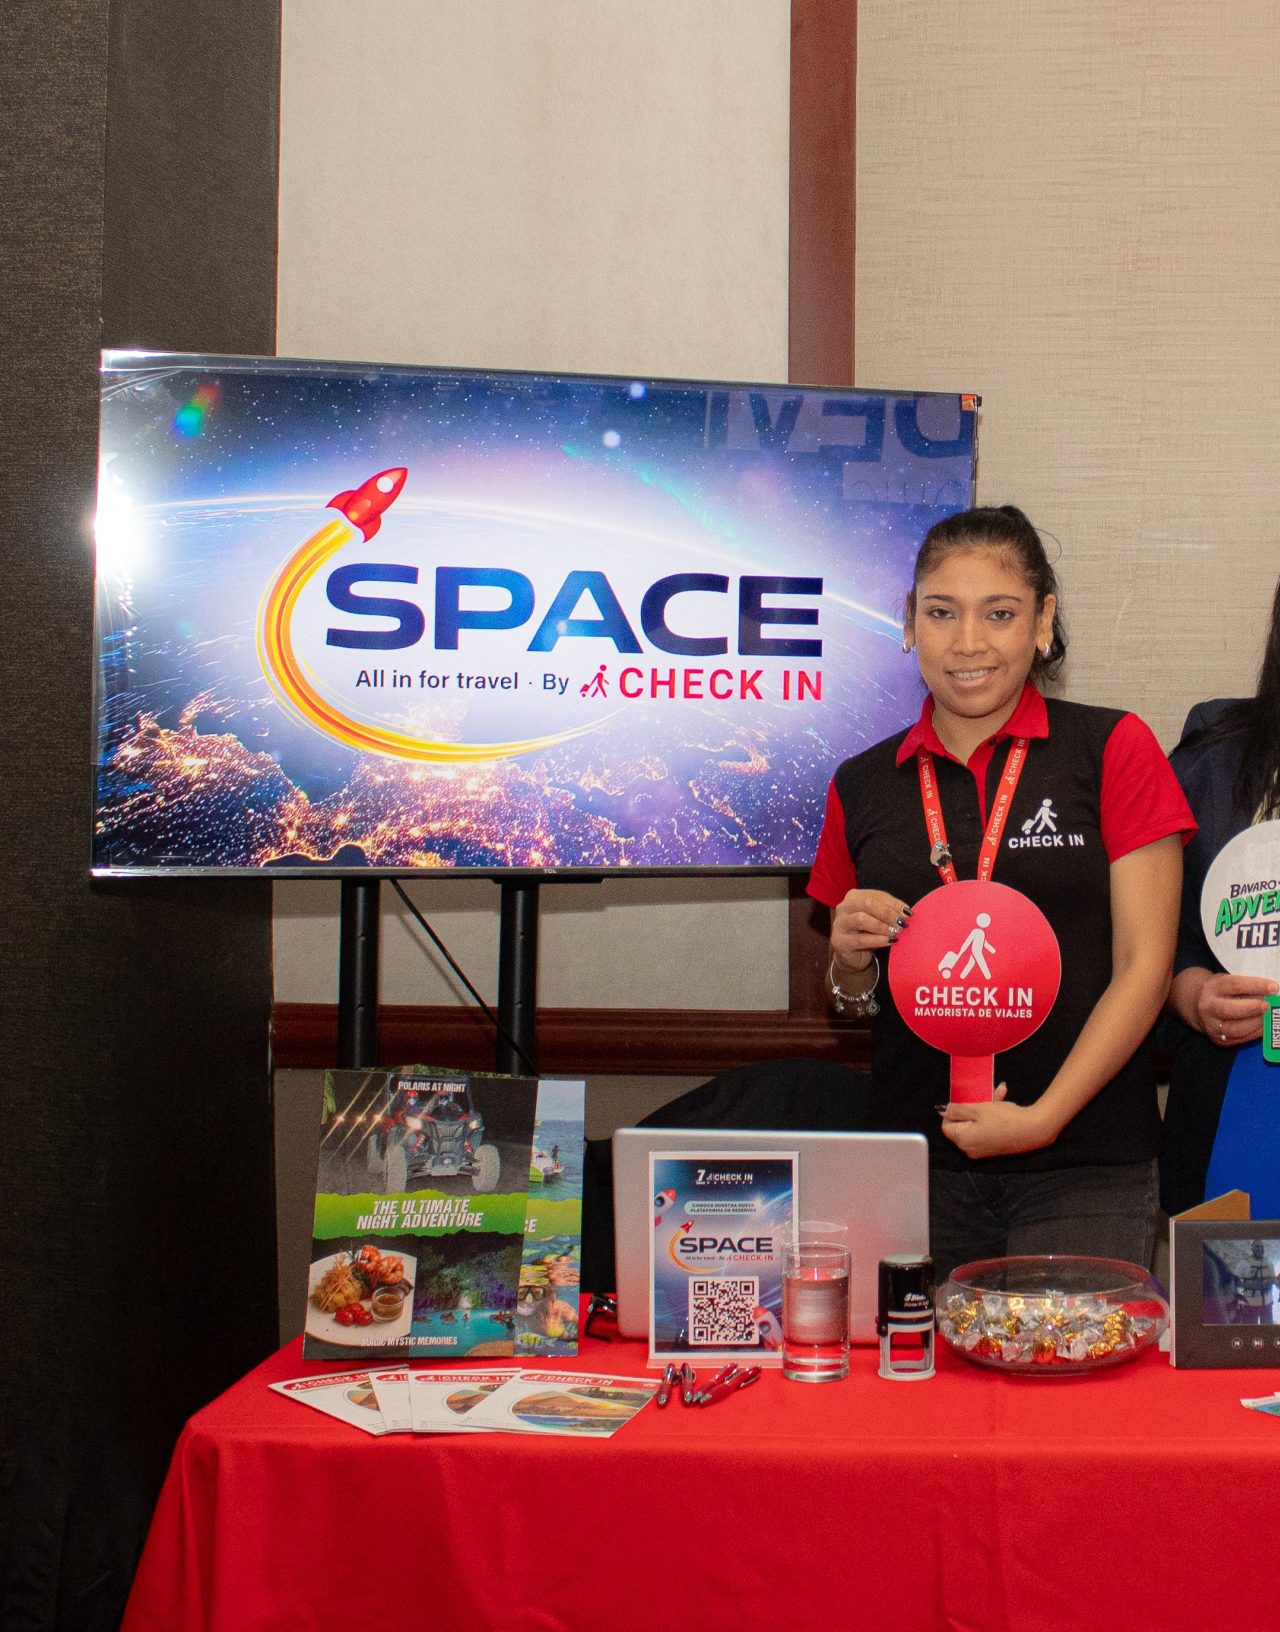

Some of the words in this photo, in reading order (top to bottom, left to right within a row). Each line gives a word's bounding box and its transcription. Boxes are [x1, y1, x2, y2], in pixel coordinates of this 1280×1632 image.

[325, 562, 824, 657] SPACE
[356, 669, 385, 688] All
[393, 670, 411, 689] in
[419, 669, 450, 689] for
[456, 670, 519, 690] travel
[543, 673, 569, 694] By
[619, 667, 763, 700] CHECK
[783, 670, 823, 701] IN
[1009, 748, 1022, 774] CHECK
[922, 765, 932, 788] CHECK
[991, 805, 1005, 834] CHECK
[1000, 794, 1008, 803] IN
[930, 818, 941, 842] CHEC
[1008, 835, 1064, 849] CHECK
[1070, 834, 1085, 847] IN
[983, 857, 991, 865] IN
[1230, 880, 1277, 898] BAVARO
[1238, 922, 1280, 948] THE
[915, 986, 998, 1006] CHECK
[1008, 987, 1033, 1007] IN
[914, 1007, 975, 1018] MAYORISTA
[979, 1008, 992, 1018] DE
[995, 1008, 1033, 1019] VIAJES
[398, 1081, 429, 1091] POLARIS
[431, 1082, 442, 1091] AT
[443, 1083, 466, 1092] NIGHT
[714, 1173, 741, 1181] CHECK
[373, 1200, 399, 1215] THE
[401, 1199, 471, 1215] ULTIMATE
[356, 1214, 399, 1230] NIGHT
[401, 1213, 484, 1228] ADVENTURE
[679, 1237, 774, 1253] SPACE
[387, 1337, 417, 1347] MYSTIC
[417, 1336, 458, 1345] MEMORIES
[547, 1375, 593, 1385] CHECK
